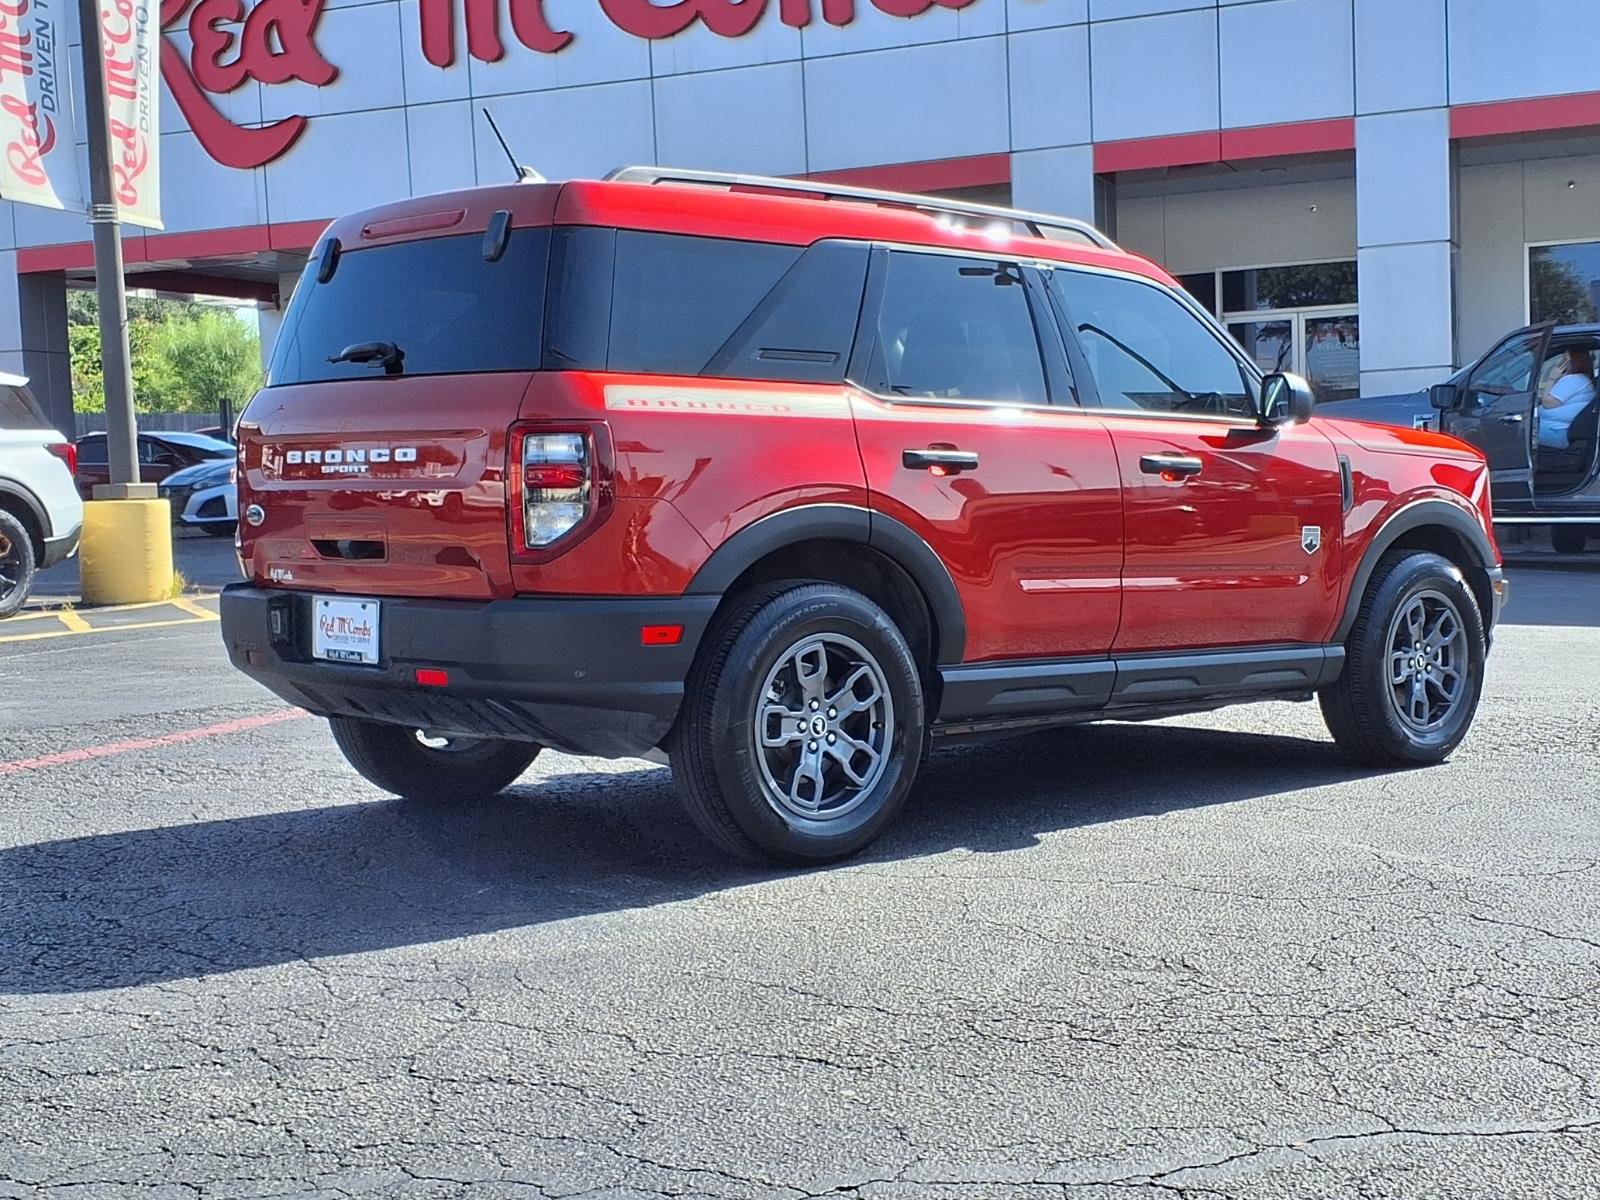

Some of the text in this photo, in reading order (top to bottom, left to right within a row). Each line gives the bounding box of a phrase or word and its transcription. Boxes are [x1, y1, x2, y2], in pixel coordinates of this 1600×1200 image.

[35, 17, 55, 113] DRIVEN
[136, 6, 149, 133] DRIVEN TO
[1, 94, 56, 187] Red
[111, 118, 148, 206] Red
[286, 448, 417, 464] BRONCO
[321, 465, 368, 473] SPORT
[320, 614, 335, 638] Red
